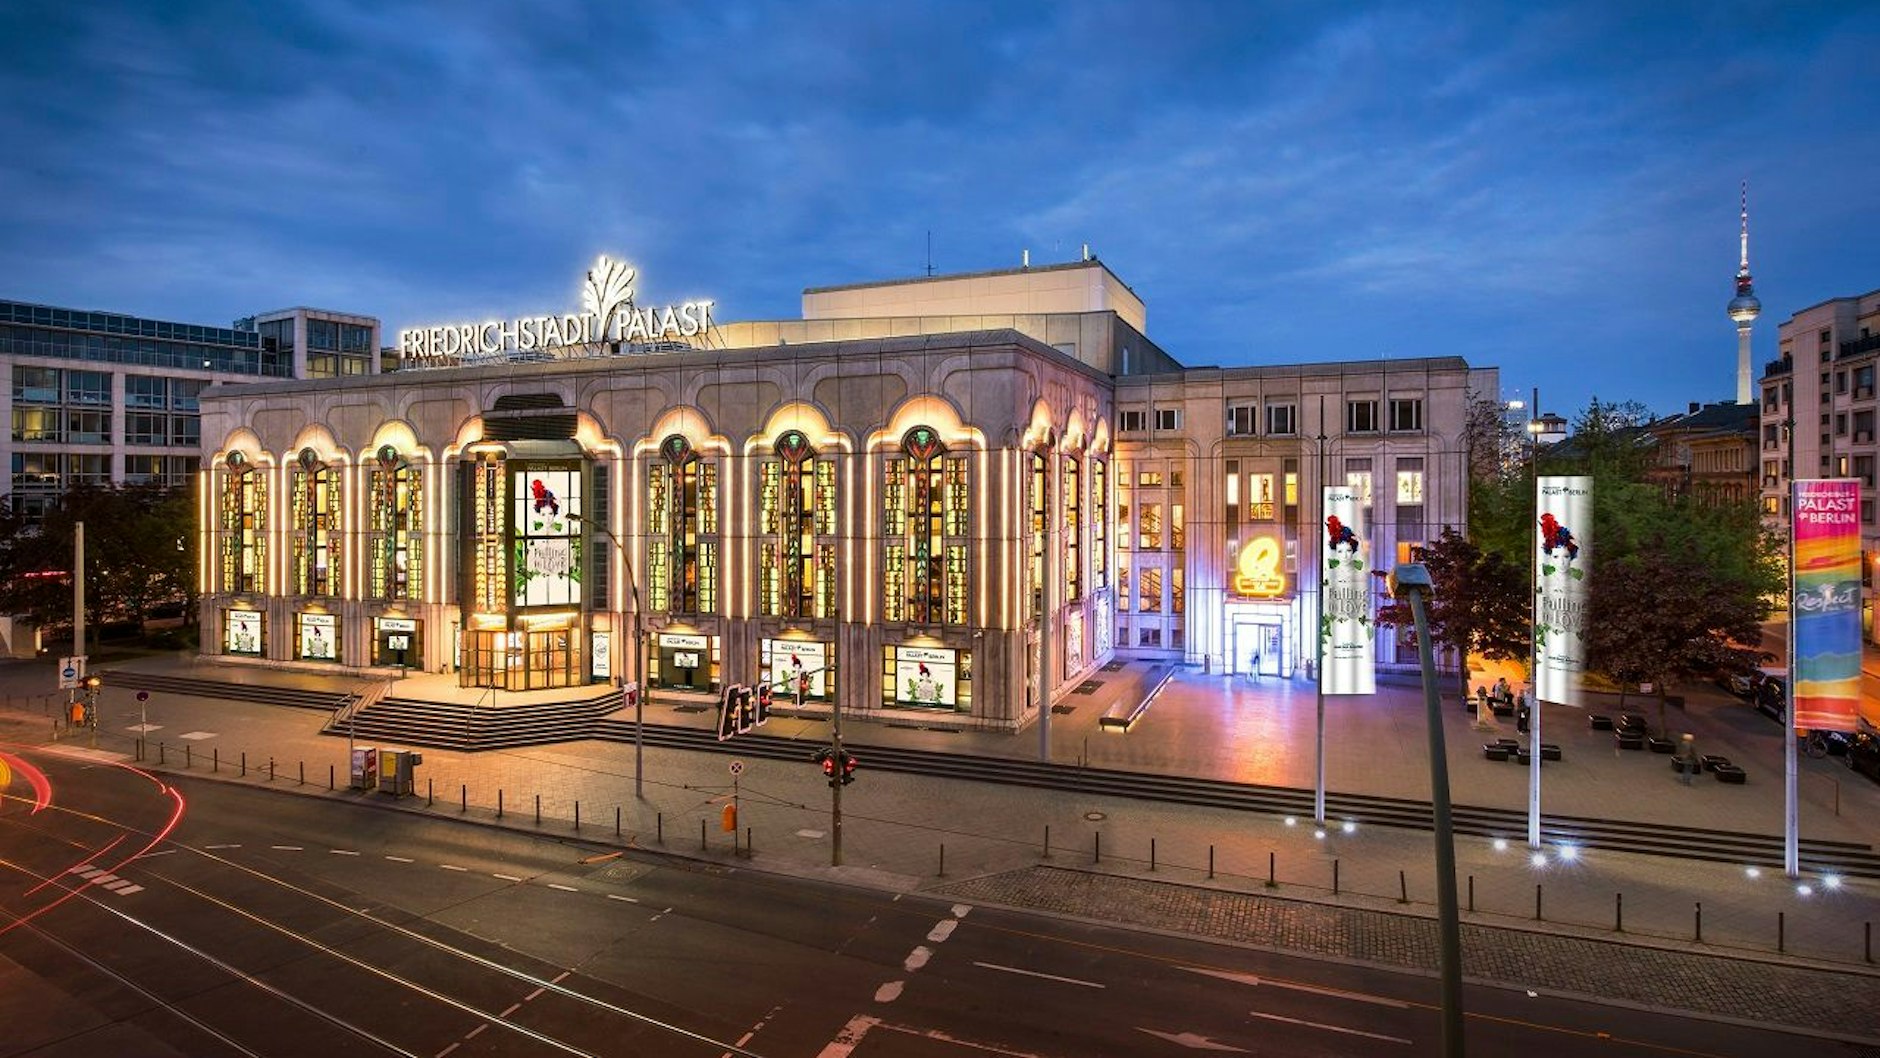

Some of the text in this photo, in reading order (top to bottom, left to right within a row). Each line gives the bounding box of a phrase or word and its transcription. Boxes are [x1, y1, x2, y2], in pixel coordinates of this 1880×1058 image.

[399, 301, 715, 358] FRIEDRICHSTADT PALAST
[1798, 498, 1856, 511] PALAST
[1810, 512, 1856, 524] BERLIN
